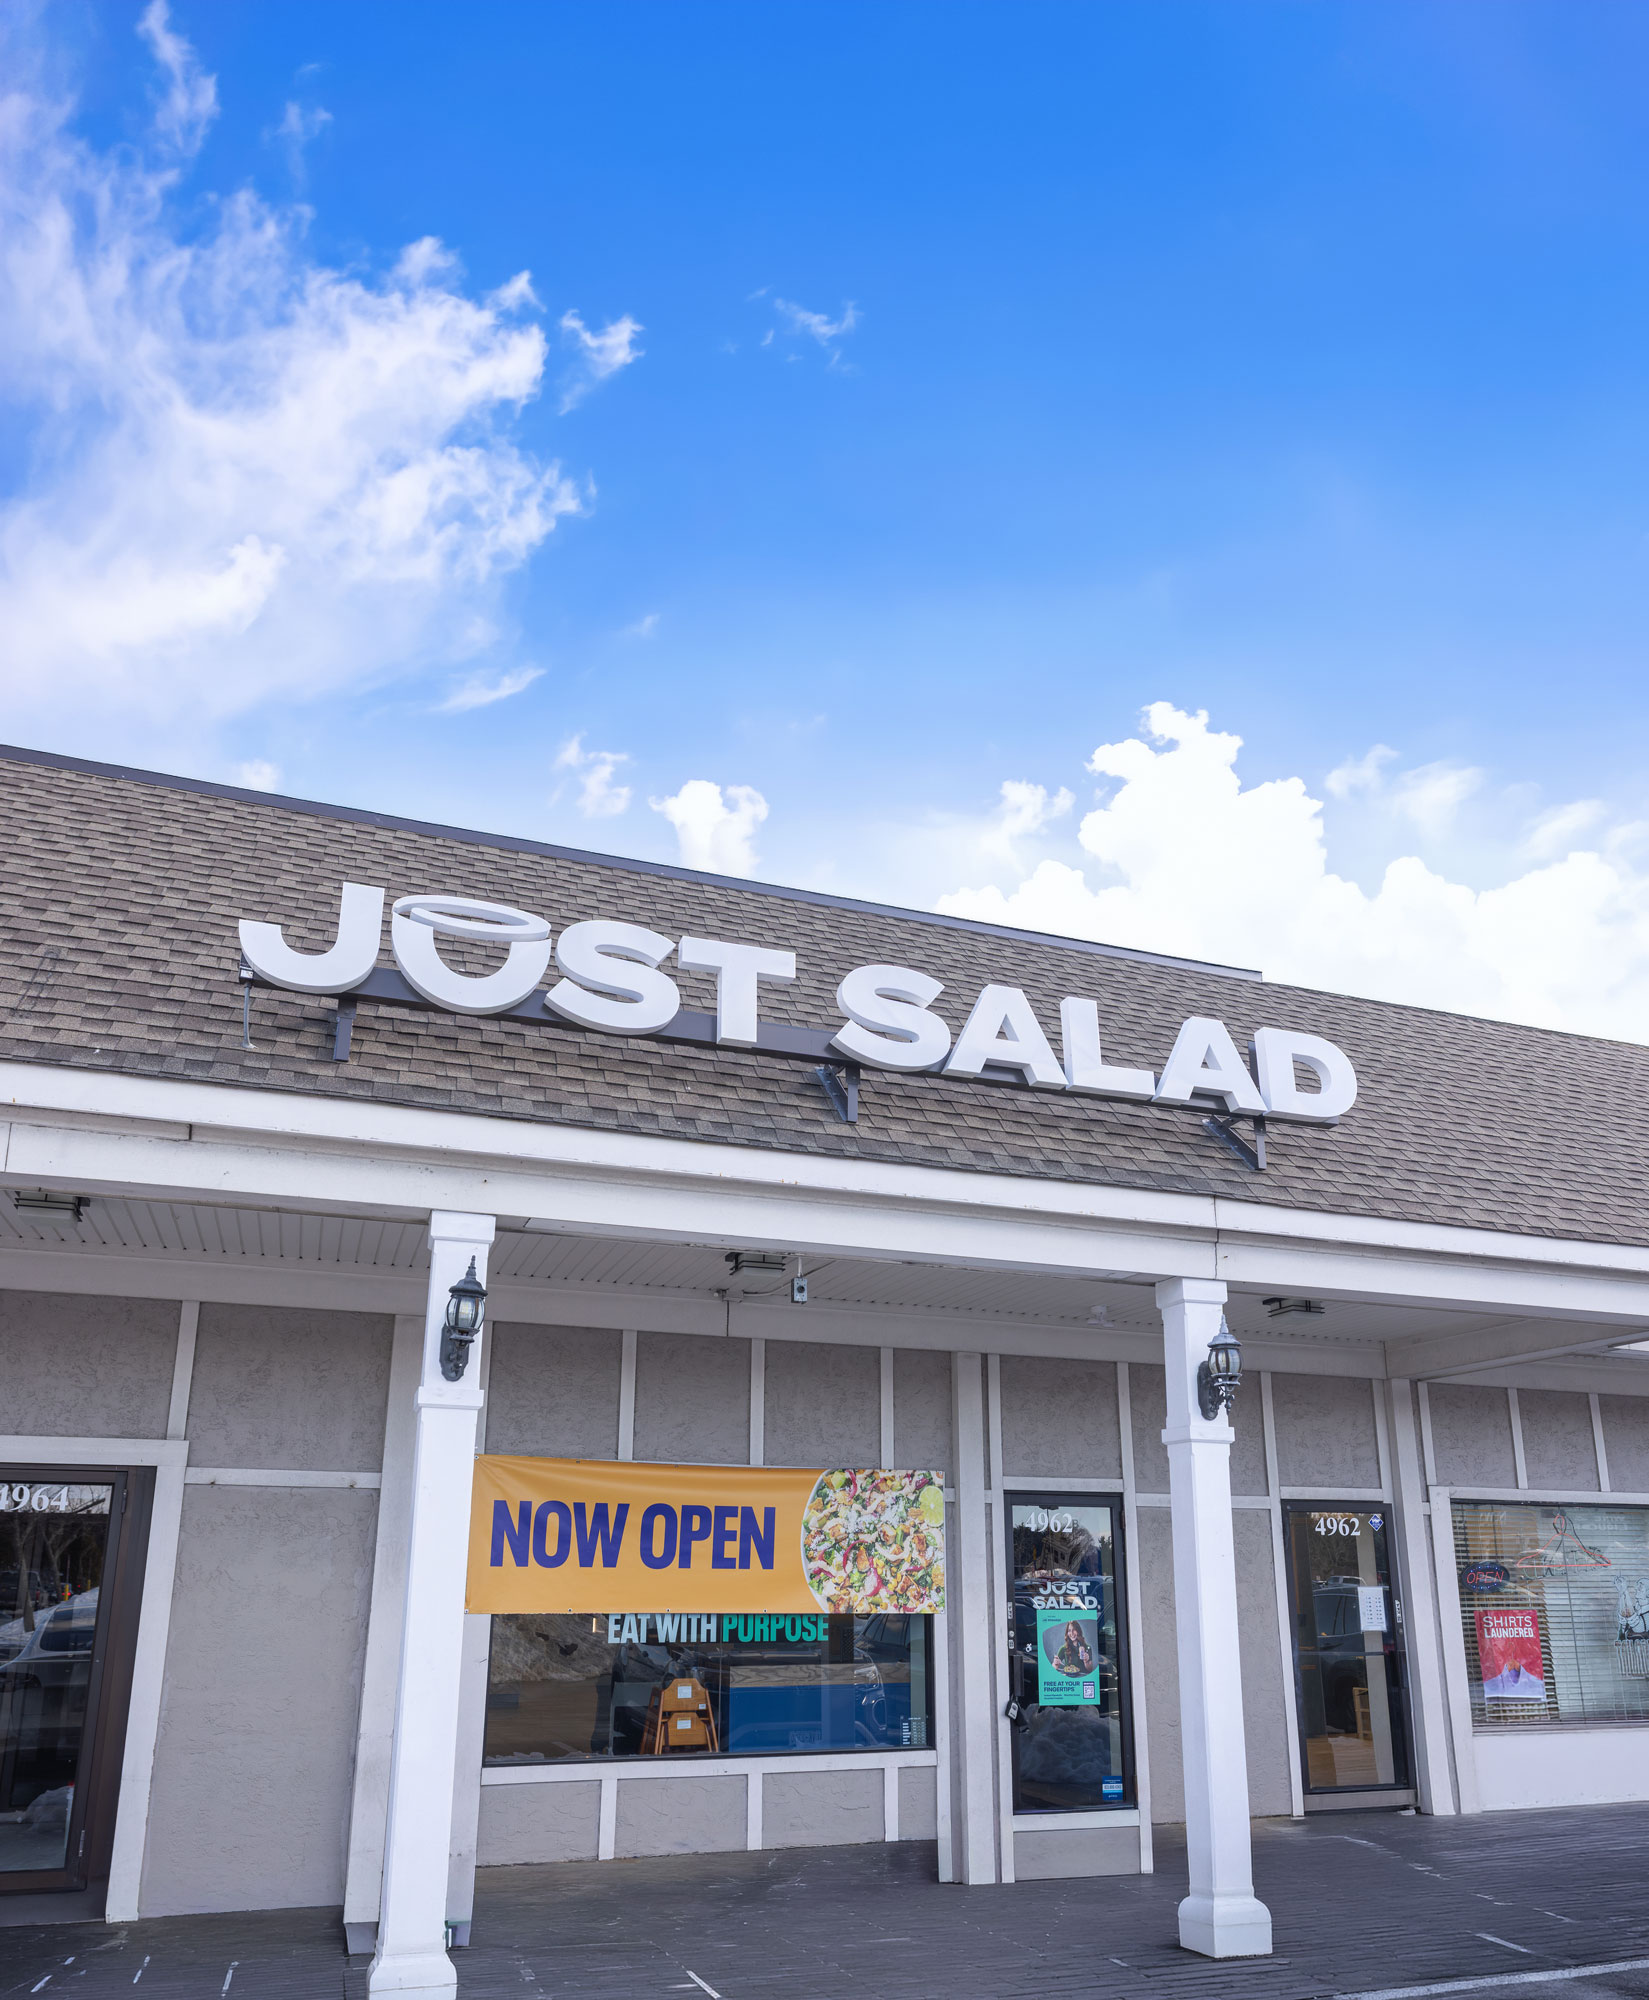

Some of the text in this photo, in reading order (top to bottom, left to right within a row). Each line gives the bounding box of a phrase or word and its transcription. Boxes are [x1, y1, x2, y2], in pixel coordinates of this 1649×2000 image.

[238, 882, 1358, 1125] JUST SALAD
[1025, 1511, 1073, 1533] 4962
[1315, 1516, 1361, 1537] 4962
[489, 1500, 777, 1570] NOW OPEN
[1466, 1571, 1504, 1584] OPEN
[1039, 1581, 1091, 1595] JUST
[1032, 1595, 1098, 1610] SALAD
[607, 1613, 829, 1644] EAT WITH PURPOSE
[1482, 1615, 1533, 1628] SHIRTS
[1483, 1627, 1534, 1638] LAUNDERED
